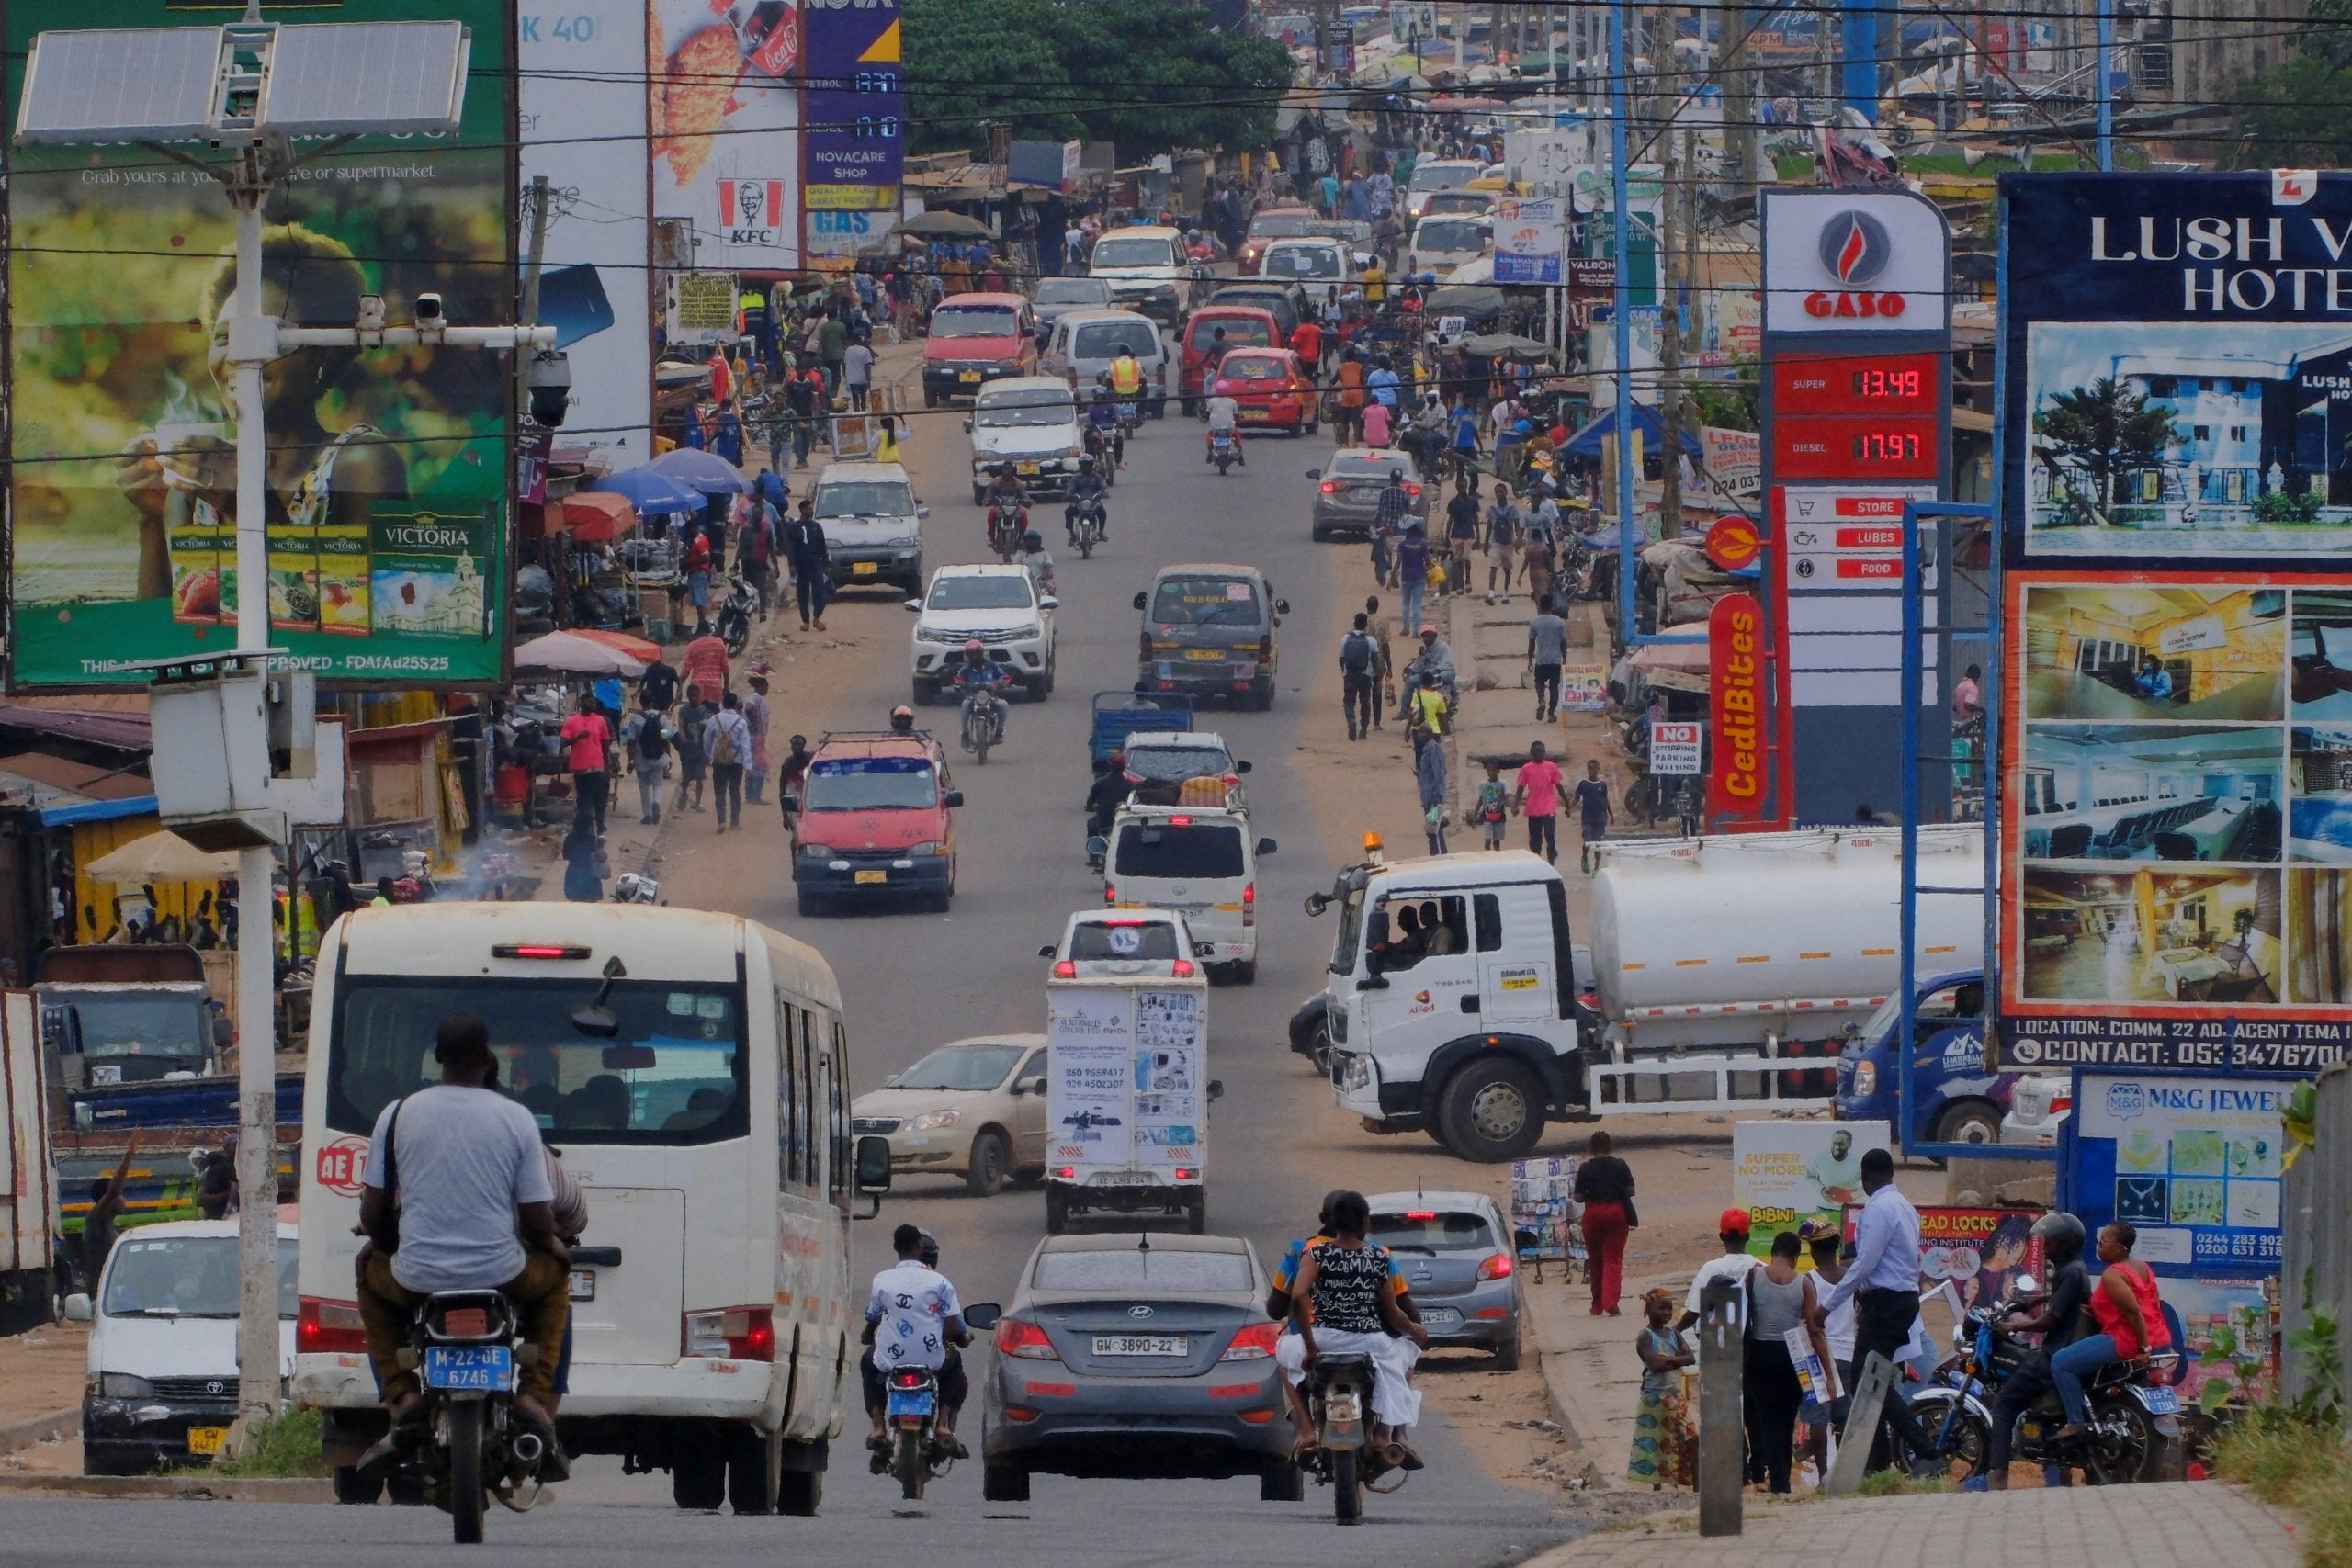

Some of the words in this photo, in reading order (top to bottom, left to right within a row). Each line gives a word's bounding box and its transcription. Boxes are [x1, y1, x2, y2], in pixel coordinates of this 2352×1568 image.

[553, 16, 594, 42] 40
[816, 151, 886, 163] NOVACARE
[82, 169, 119, 184] Grab
[123, 171, 166, 186] yours
[172, 170, 186, 184] at
[191, 171, 221, 186] you
[314, 168, 334, 180] or
[834, 167, 867, 178] SHOP
[815, 210, 869, 234] GAS
[731, 230, 771, 243] KFC
[2091, 216, 2283, 261] LUSH
[1804, 292, 1905, 318] GASO
[1793, 380, 1826, 389] SUPER
[1863, 371, 1919, 397] 13.49
[2302, 375, 2351, 388] LUSH
[1793, 444, 1826, 453] DIESEL
[1863, 434, 1919, 459] 17.97
[1858, 502, 1894, 513] STORE
[386, 528, 469, 546] VICTORIA
[1858, 533, 1894, 543] LUBES
[175, 540, 211, 548] VICTORIA
[274, 542, 309, 550] VICTORIA
[1861, 563, 1891, 574] FOOD
[1723, 611, 1757, 797] CediBites
[1663, 727, 1690, 740] NO
[1655, 745, 1697, 753] STOPPING
[1408, 1003, 1435, 1014] Allied
[2016, 1020, 2105, 1035] LOCATION:
[2110, 1021, 2166, 1036] COMM.
[2173, 1022, 2194, 1037] 22
[2295, 1024, 2340, 1039] TEMA
[2045, 1040, 2170, 1064] CONTACT:
[2149, 1089, 2203, 1110] M&G
[1746, 1153, 1801, 1165] SUFFER
[1738, 1165, 1759, 1176] NO
[1764, 1164, 1806, 1176] MORE
[1750, 1206, 1795, 1224] BIBINI
[1952, 1215, 1997, 1232] LOCKS
[1939, 1239, 1985, 1247] INSTITUTE
[2196, 1233, 2228, 1244] 0244
[2233, 1235, 2256, 1246] 283
[2259, 1235, 2282, 1246] 902
[2196, 1244, 2228, 1255] 0200
[2232, 1245, 2254, 1256] 631
[2259, 1246, 2282, 1257] 318
[1096, 1339, 1112, 1352] GW
[1121, 1339, 1173, 1352] 3890-22
[449, 1369, 489, 1384] 6746
